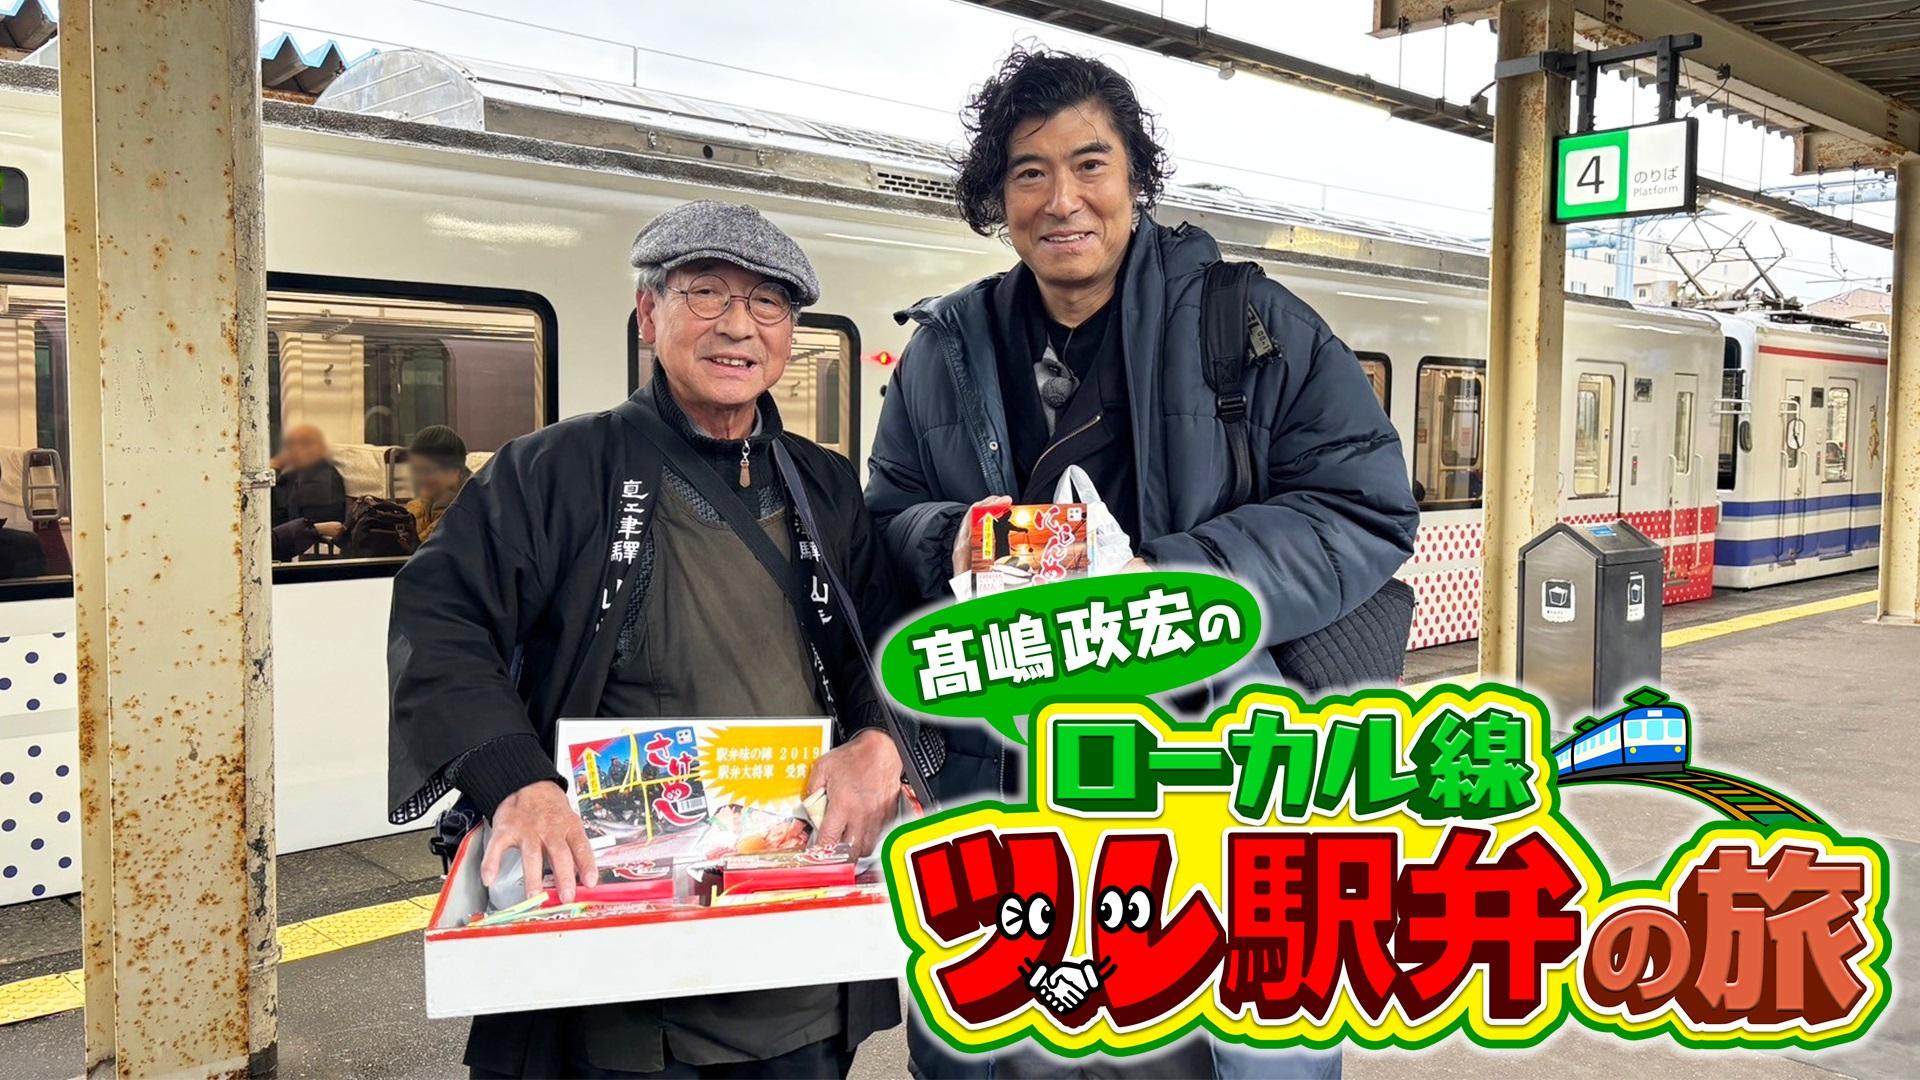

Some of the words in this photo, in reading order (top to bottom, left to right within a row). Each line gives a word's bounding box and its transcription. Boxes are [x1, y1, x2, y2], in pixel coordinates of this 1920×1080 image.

[1577, 155, 1605, 194] 4
[1633, 165, 1679, 184] のりば
[1633, 185, 1679, 197] Platform
[779, 747, 820, 760] 2019
[645, 733, 707, 826] さけめし
